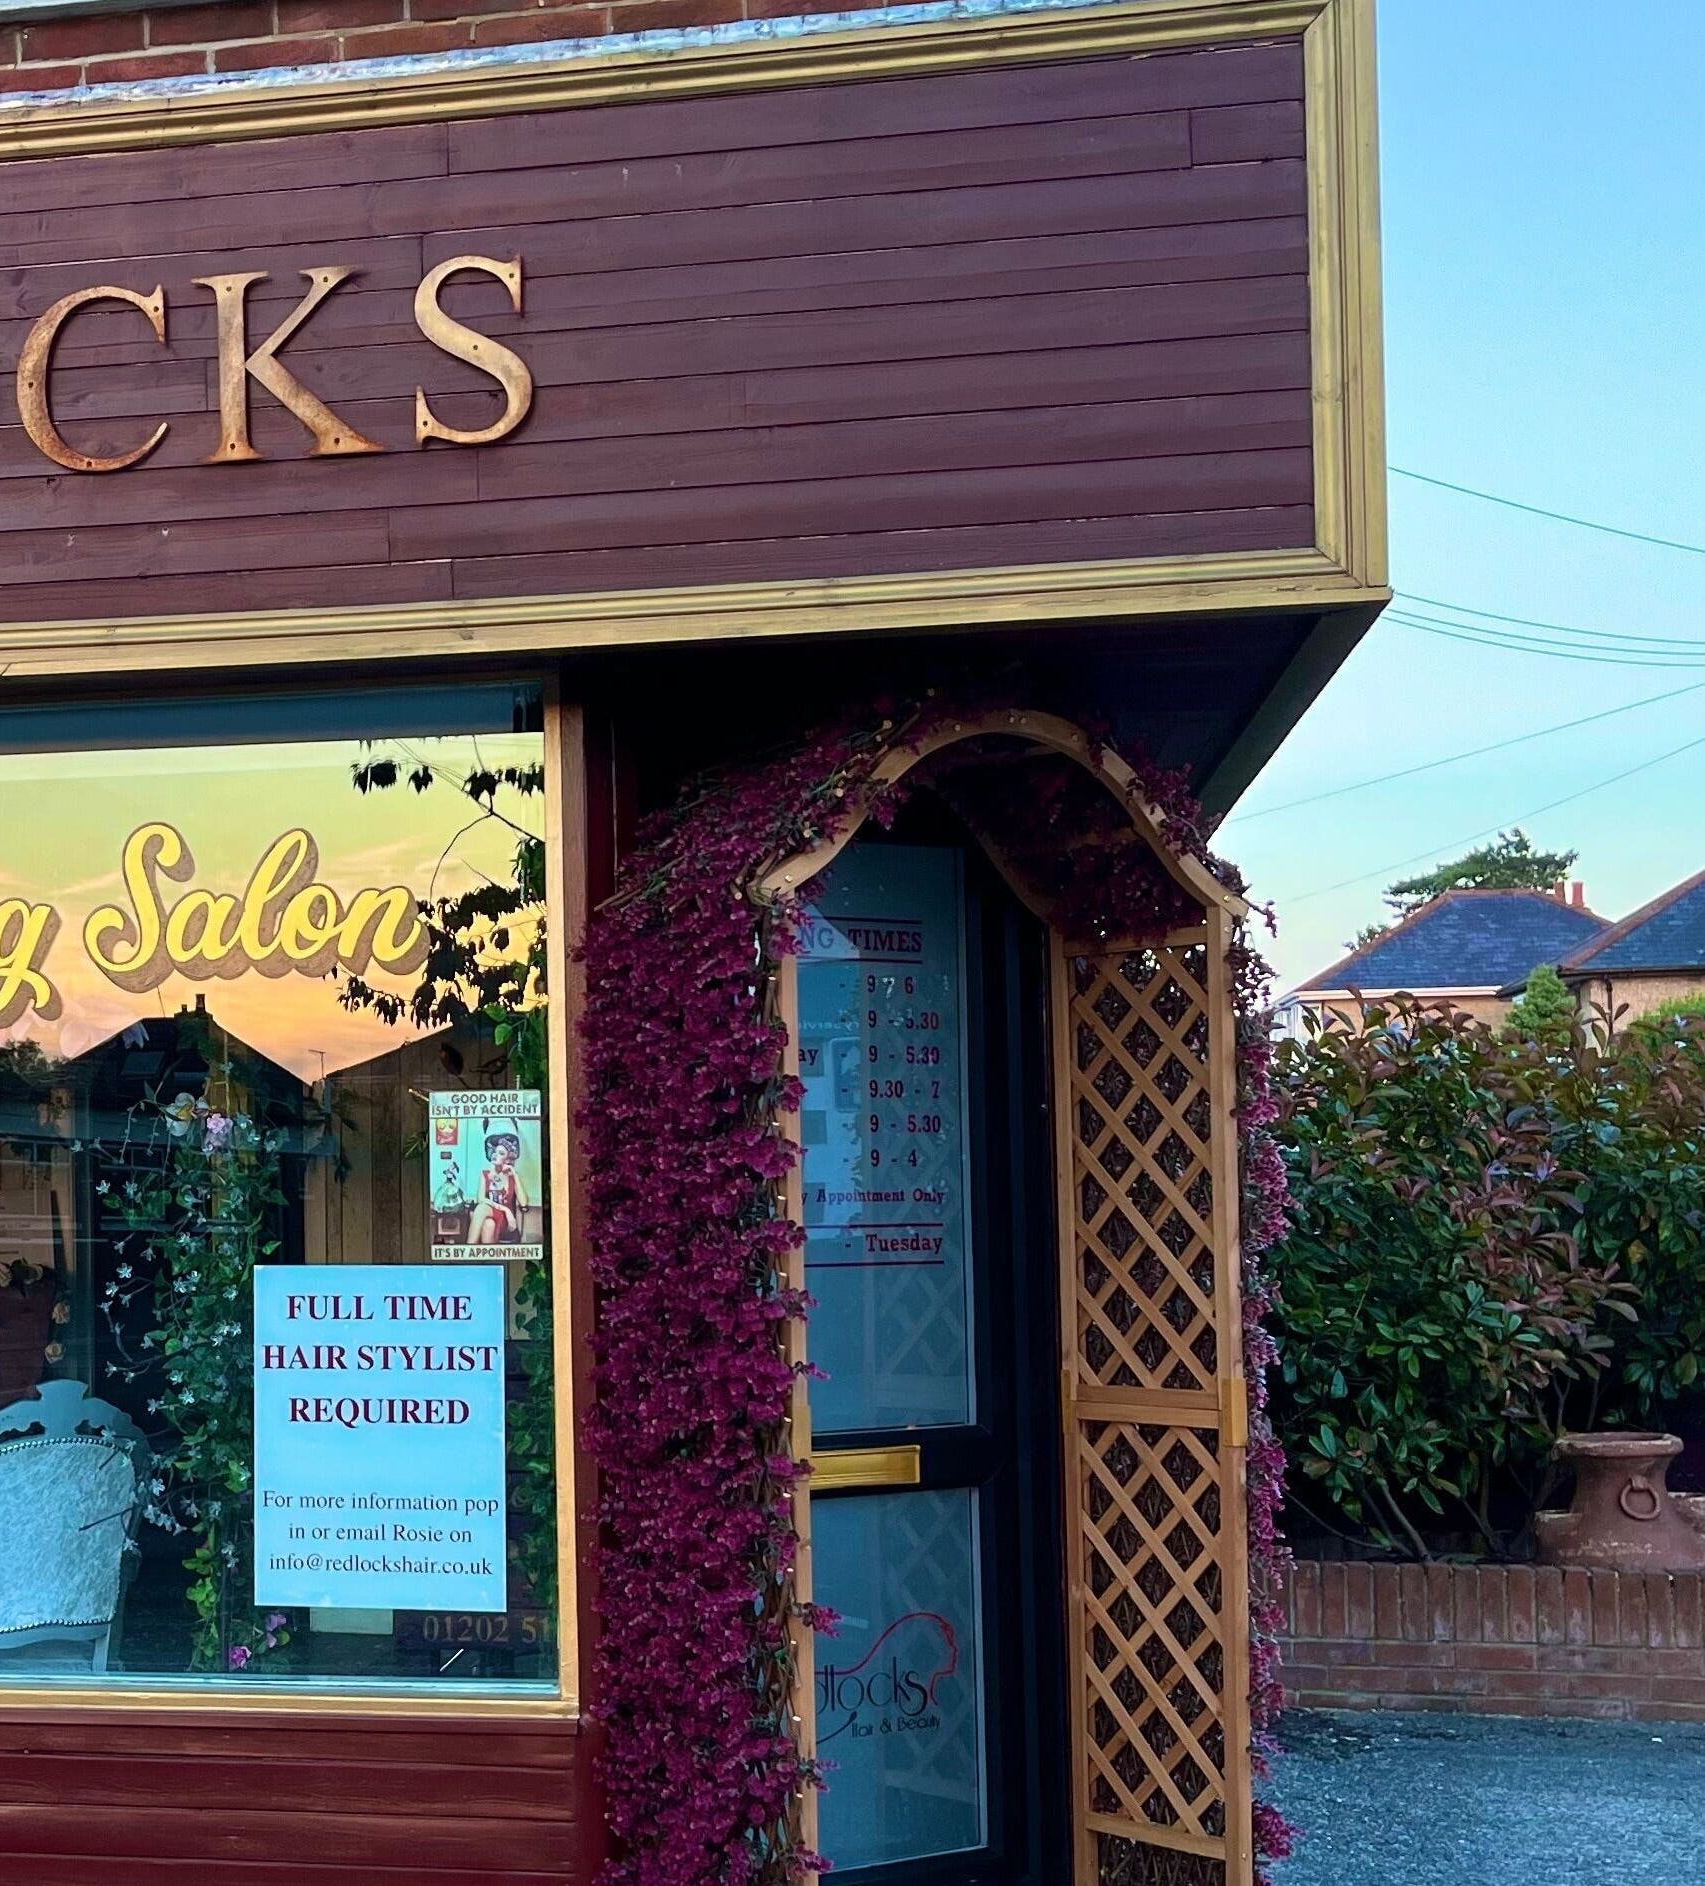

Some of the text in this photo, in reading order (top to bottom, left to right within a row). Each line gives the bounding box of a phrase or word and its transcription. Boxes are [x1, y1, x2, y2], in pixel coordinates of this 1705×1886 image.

[90, 821, 426, 975] Salon
[848, 928, 923, 953] TIMES
[867, 974, 876, 993] 9
[904, 976, 914, 994] 6
[868, 1009, 877, 1028] 9
[869, 1045, 878, 1063] 9
[906, 1046, 940, 1065] 5.30
[450, 1093, 519, 1104] GOOD HAIR
[869, 1079, 904, 1099] 9.30
[431, 1103, 539, 1117] ISN'T BY ACCIDENT
[870, 1114, 879, 1133] 9
[907, 1114, 941, 1133] 5.30
[871, 1148, 880, 1167] 9
[908, 1148, 917, 1167] 4
[816, 1188, 905, 1205] Appointment
[912, 1188, 944, 1205] Only
[434, 1247, 540, 1258] IT'S BY APPOINTMENT
[865, 1233, 943, 1255] Tuesday
[286, 1294, 474, 1322] FULL TIME
[261, 1344, 499, 1372] HAIR STYLIST
[288, 1397, 471, 1429] REQUIRED
[262, 1490, 500, 1516] For more information pop
[288, 1522, 473, 1543] in or email Rosie on
[269, 1553, 495, 1577] info@redlockshair.co.uk
[422, 1615, 510, 1644] 01202
[816, 1656, 928, 1717] dlocks
[879, 1718, 893, 1734] &
[896, 1715, 941, 1733] Beauty
